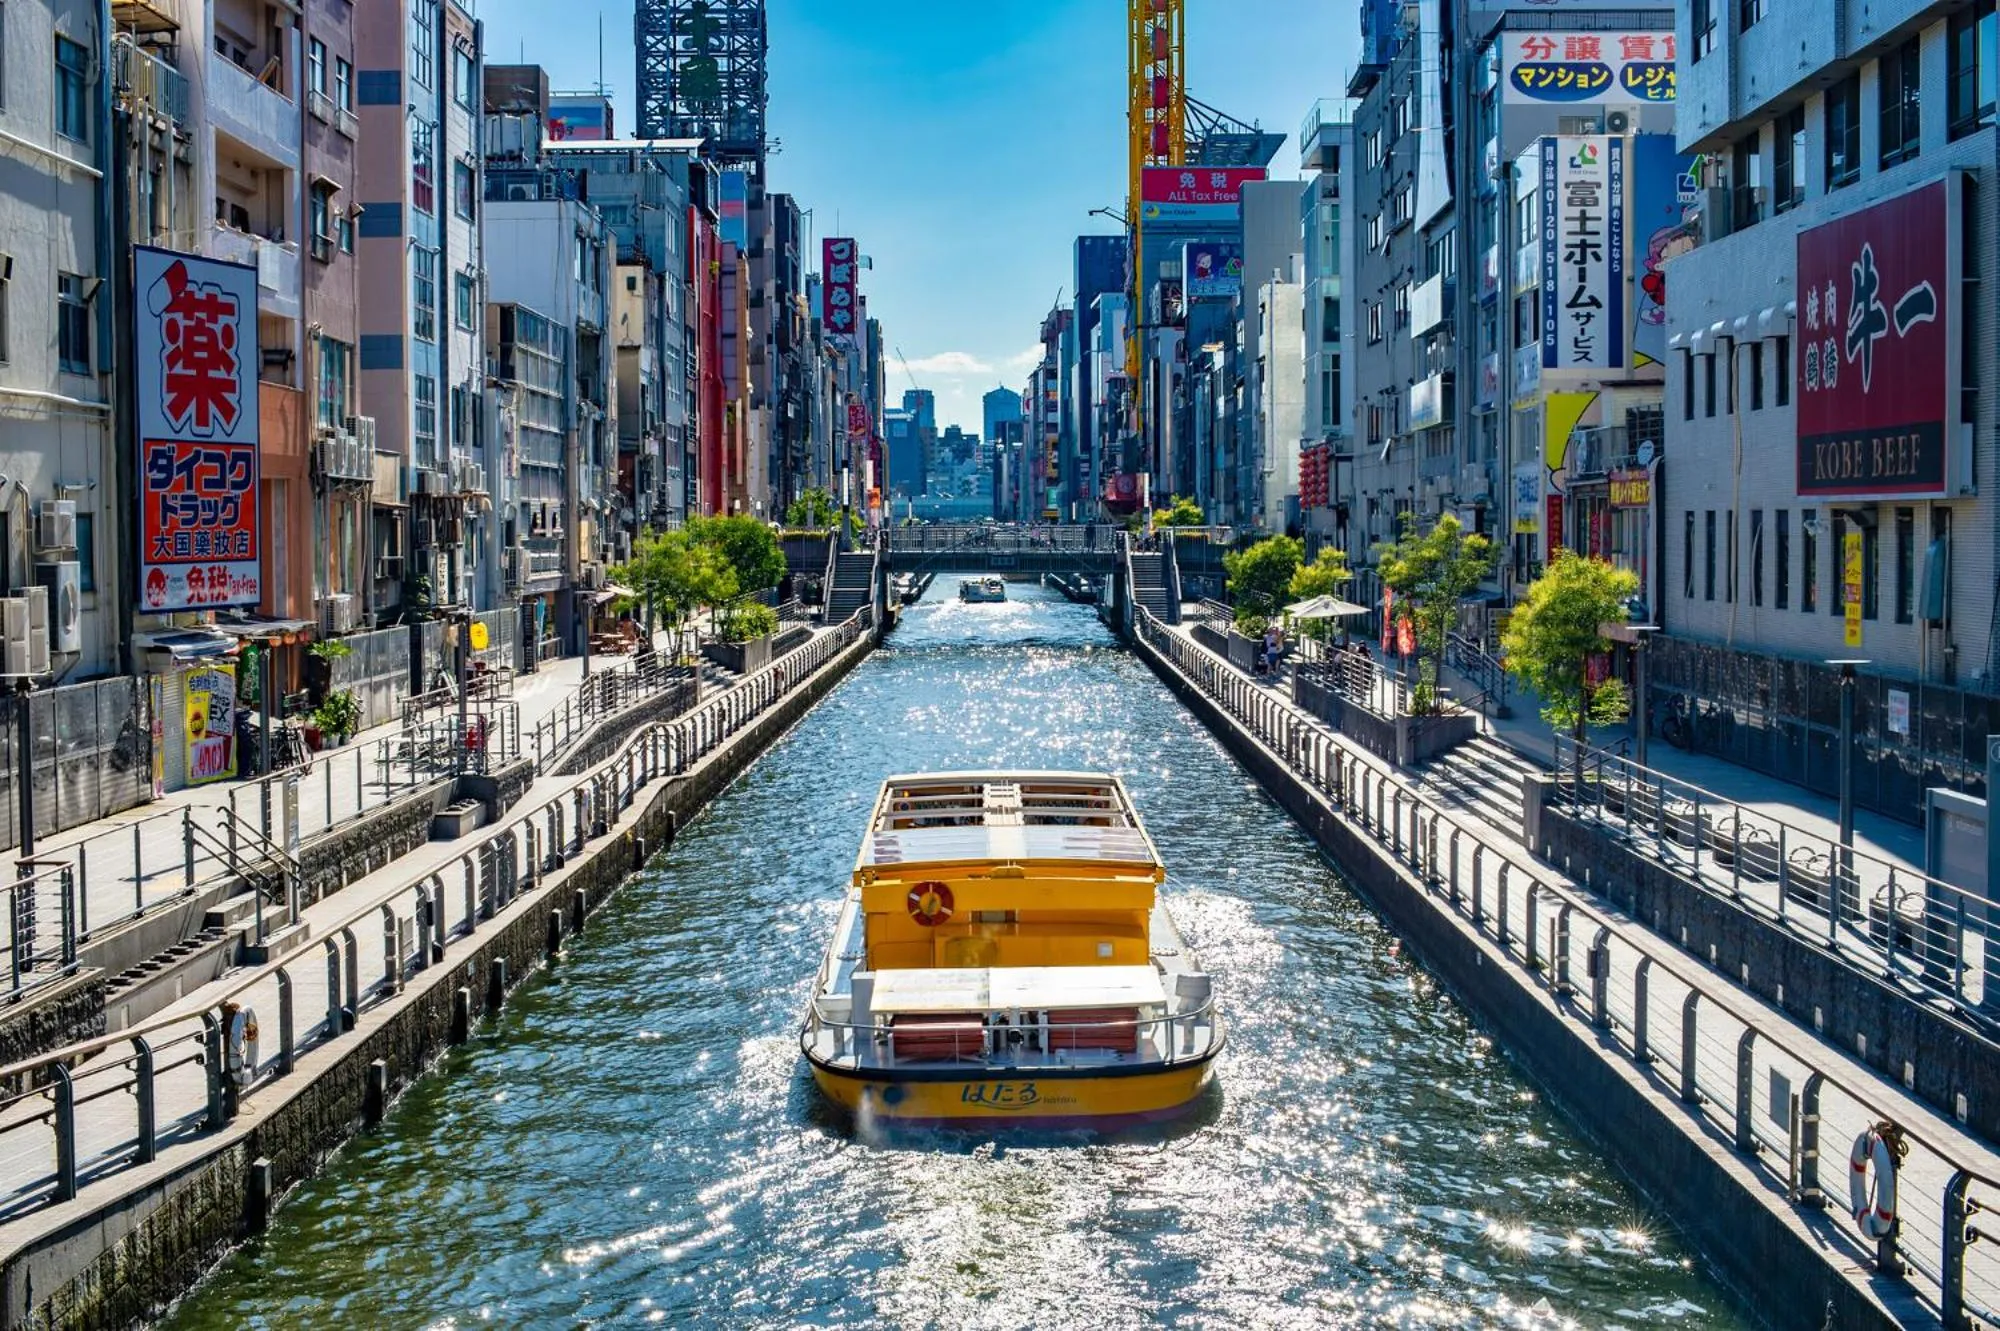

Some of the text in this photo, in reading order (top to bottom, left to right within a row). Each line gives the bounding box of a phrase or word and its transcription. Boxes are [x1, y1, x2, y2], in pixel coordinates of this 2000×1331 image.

[1520, 36, 1601, 60] 分譲
[1517, 67, 1609, 88] マンション
[1168, 191, 1238, 201] ALL Tax Free
[1564, 180, 1602, 362] 富士ホームサービス
[1806, 280, 1837, 331] 焼肉
[163, 289, 238, 430] 薬
[147, 444, 254, 491] ダイコク
[1815, 433, 1921, 480] KOBE BEEF
[160, 493, 241, 528] ドラッグ
[187, 565, 229, 605] 免税
